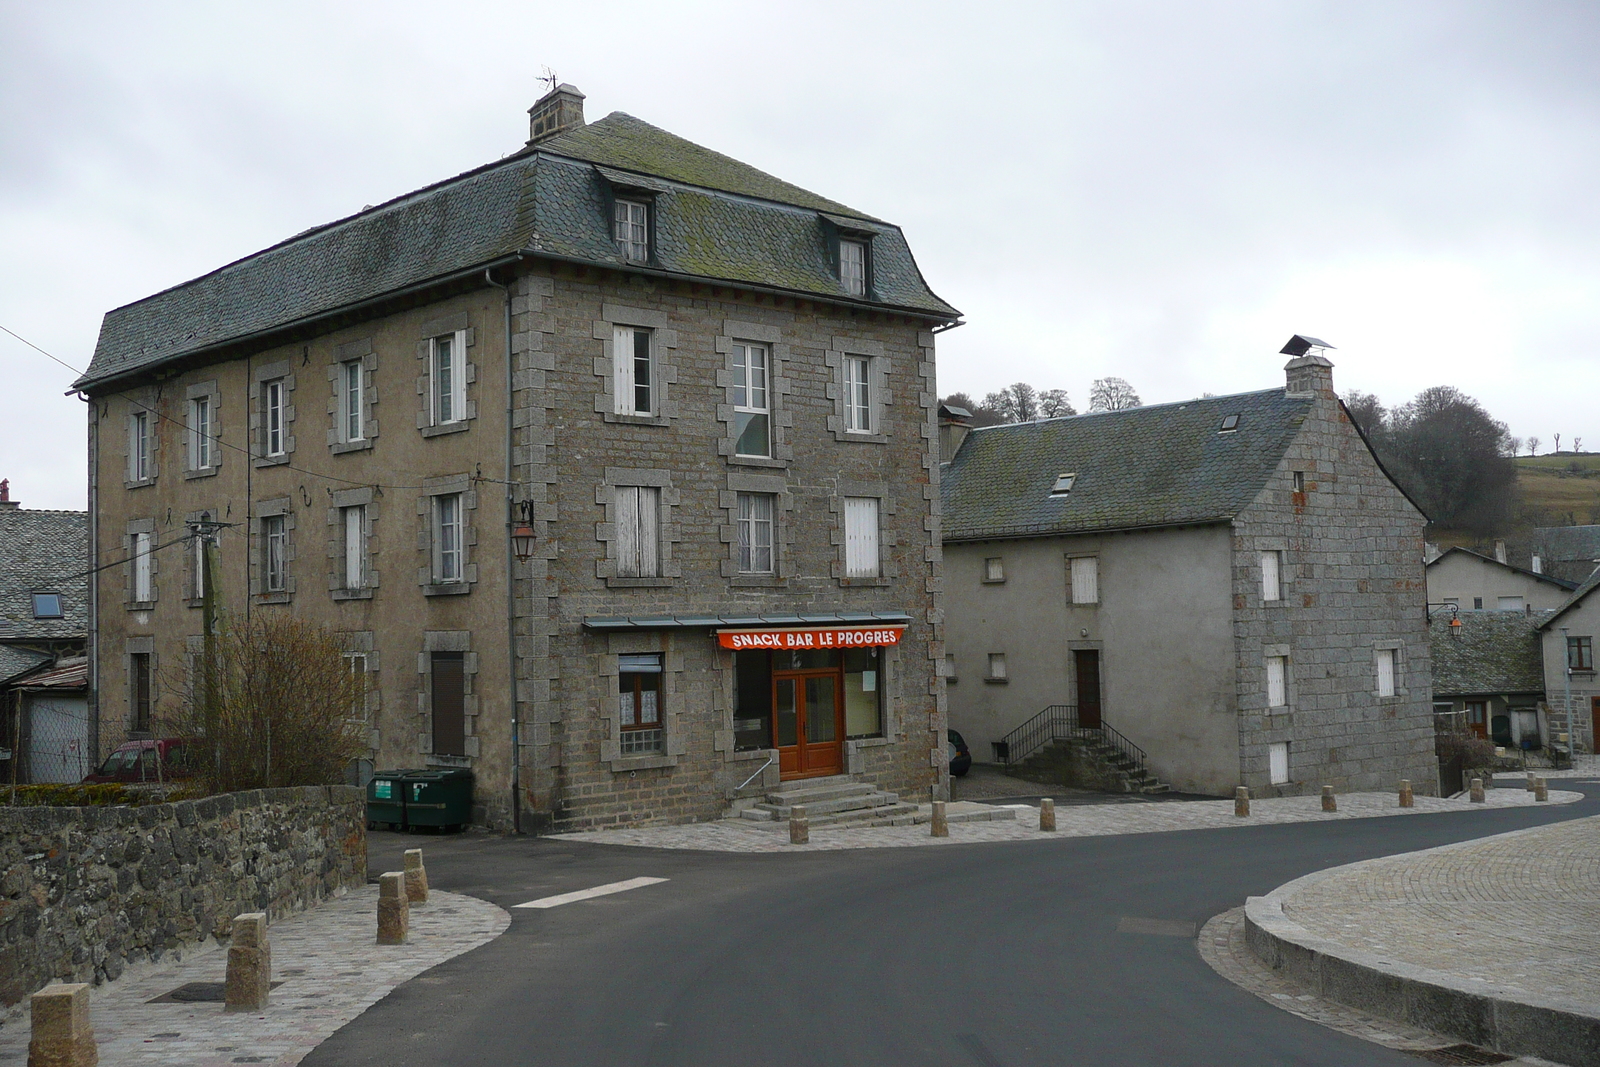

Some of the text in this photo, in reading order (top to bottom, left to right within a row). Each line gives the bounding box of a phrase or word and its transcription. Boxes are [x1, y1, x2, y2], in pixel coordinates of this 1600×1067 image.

[732, 630, 897, 648] SNACK BAR LE PROGRES
